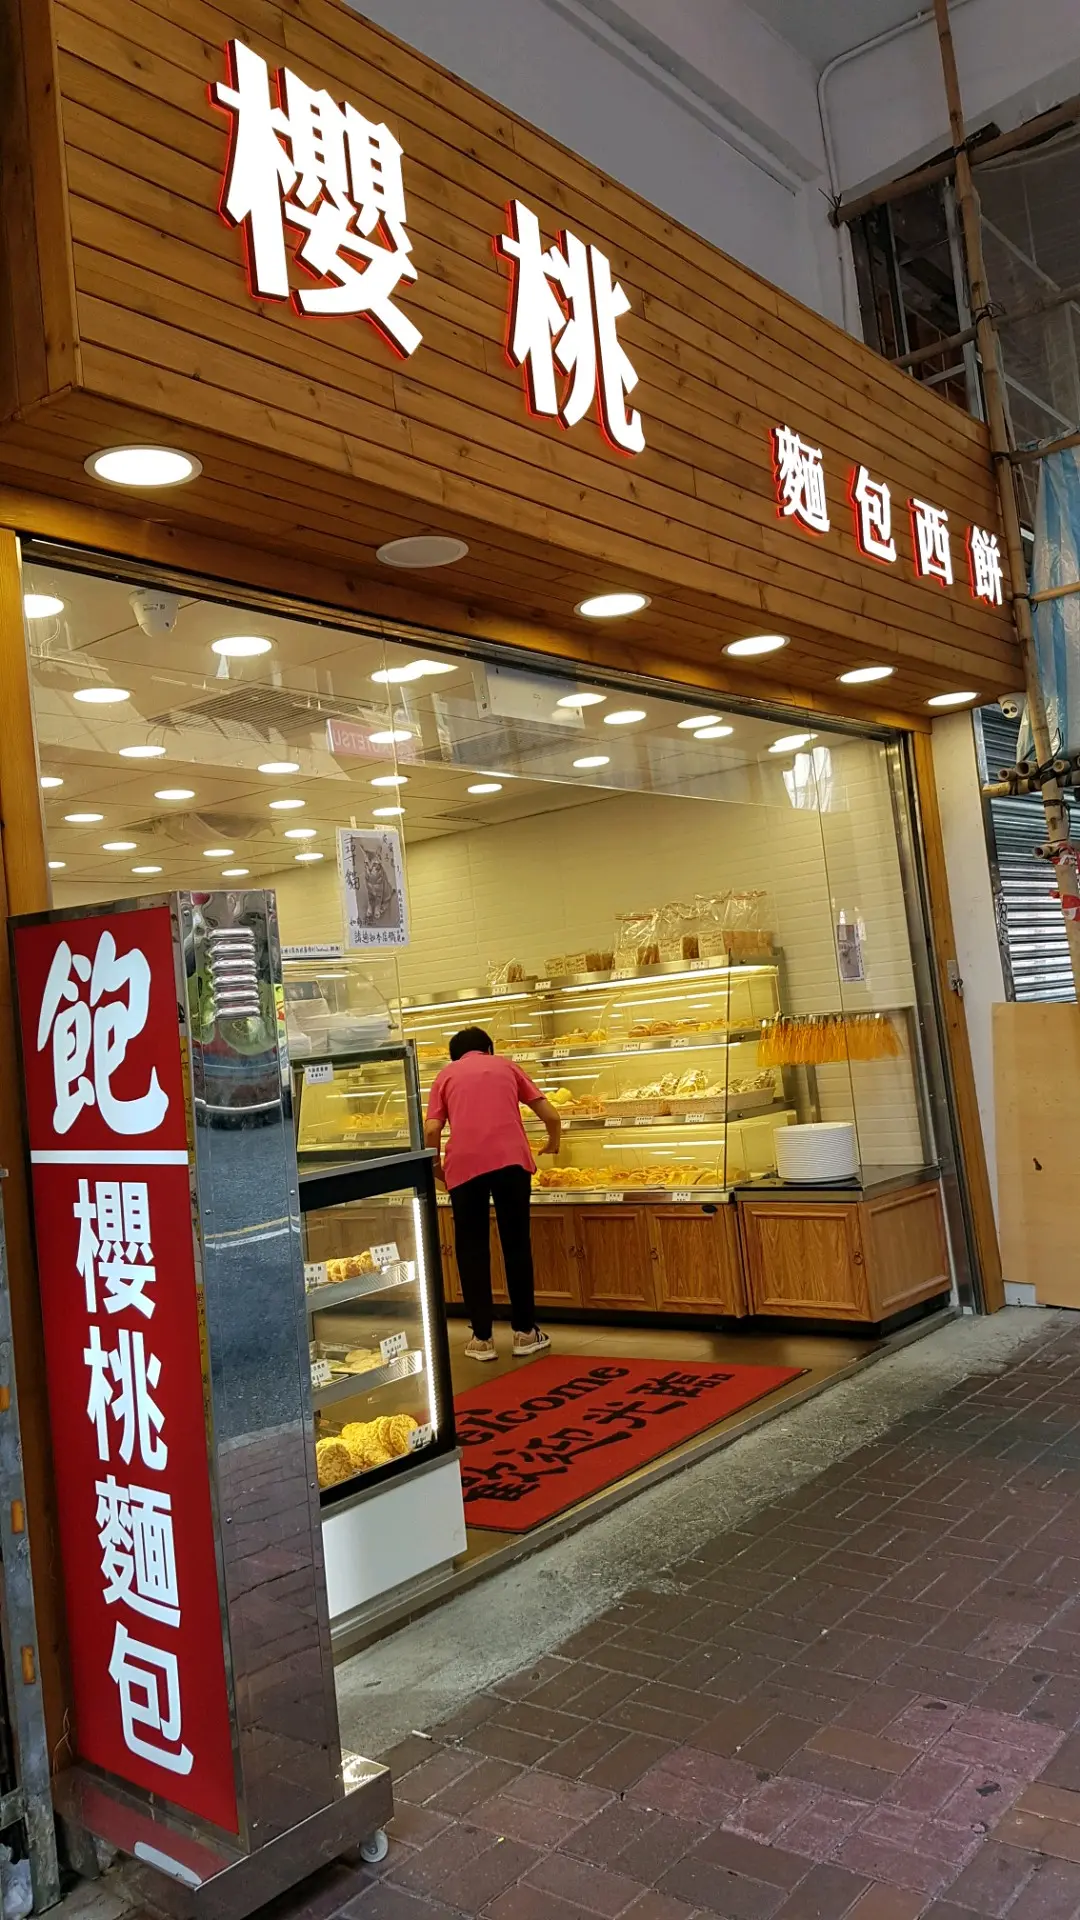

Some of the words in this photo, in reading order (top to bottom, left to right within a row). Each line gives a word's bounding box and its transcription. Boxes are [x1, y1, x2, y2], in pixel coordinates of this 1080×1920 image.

[212, 38, 646, 453] 櫻桃
[772, 424, 1003, 606] 麵包西餅
[36, 930, 169, 1136] 飽
[73, 1178, 194, 1775] 櫻桃麵包
[455, 1366, 630, 1447] elcome
